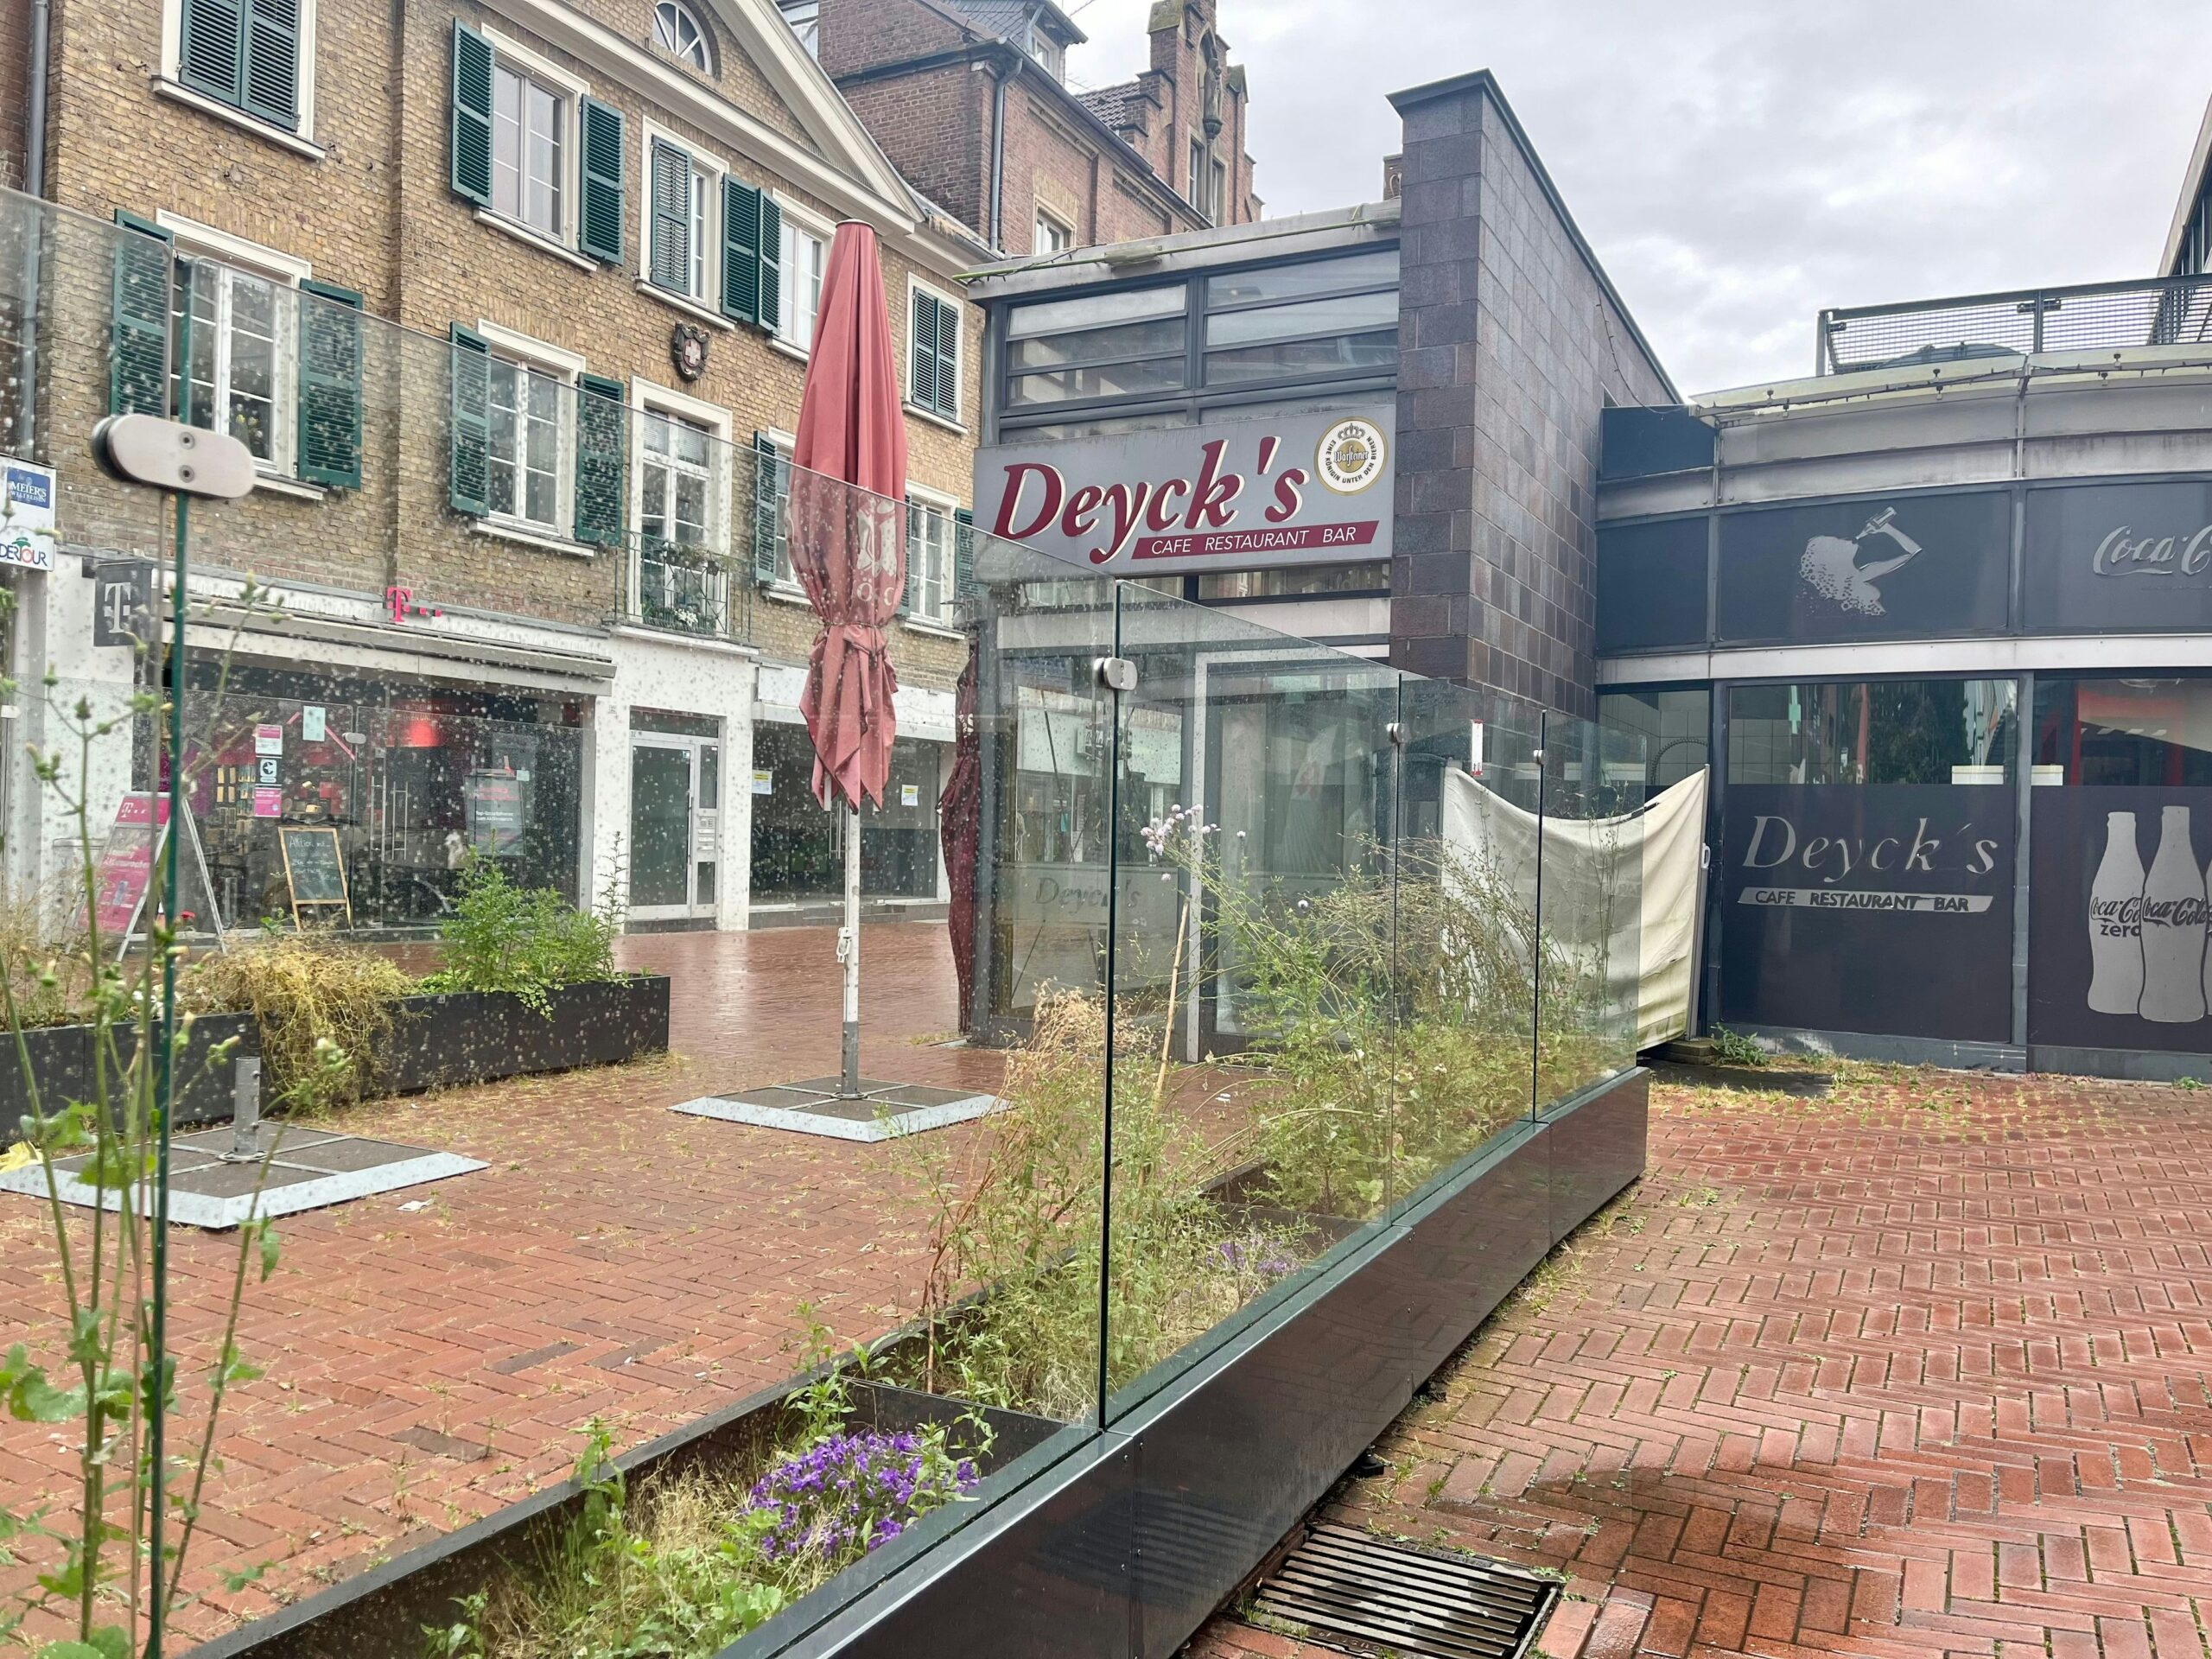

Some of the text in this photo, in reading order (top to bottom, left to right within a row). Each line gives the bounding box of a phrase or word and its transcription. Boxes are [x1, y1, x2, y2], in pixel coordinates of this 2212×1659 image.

[1325, 435, 1377, 484] EINE KÖNIGIN UNTER DEN BIEREN
[993, 435, 1311, 564] Deyck's
[1151, 526, 1357, 555] CAFE RESTAURANT BAR
[1033, 876, 1141, 914] Deyc's
[1755, 890, 1969, 912] CAFE RESTAURANT BAR
[2101, 924, 2141, 938] zero
